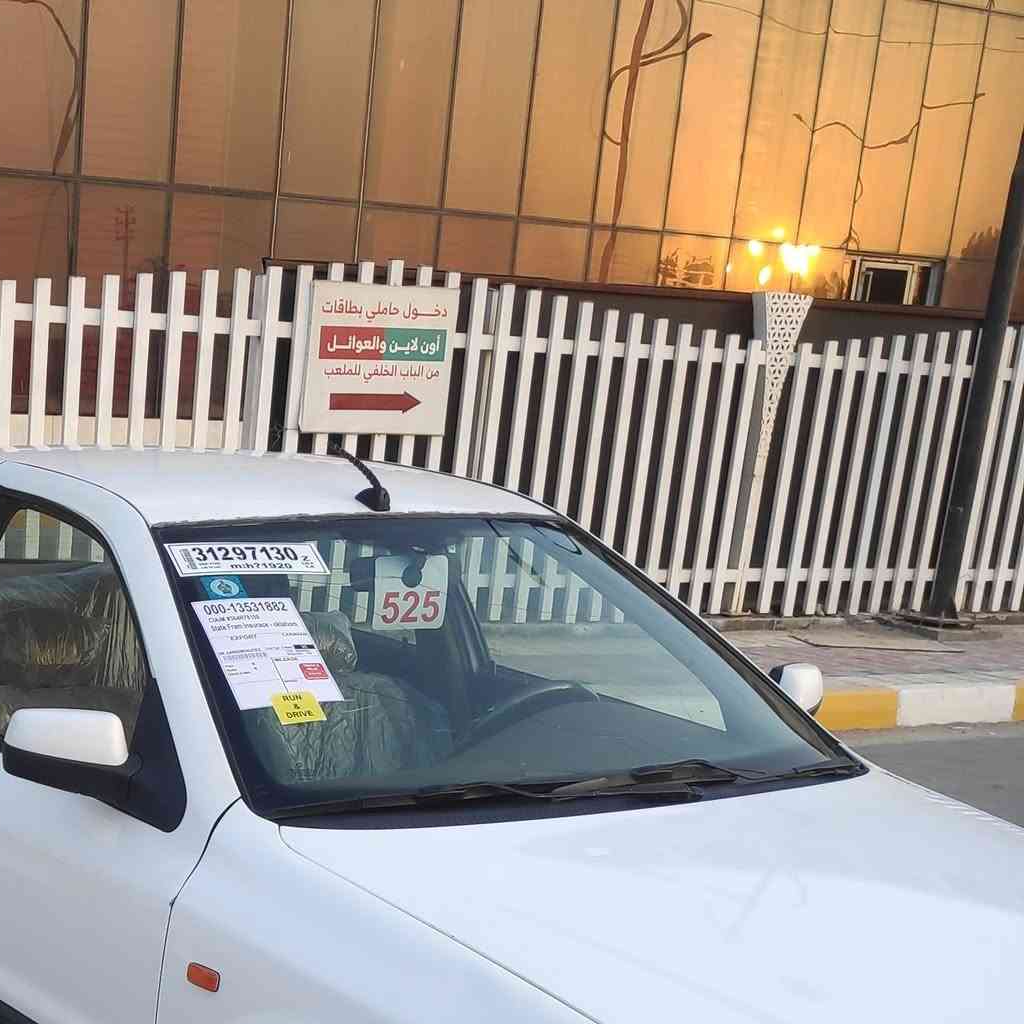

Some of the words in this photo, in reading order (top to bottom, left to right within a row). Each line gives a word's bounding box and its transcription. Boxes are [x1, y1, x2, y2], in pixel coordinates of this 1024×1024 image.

[321, 297, 363, 319] بطاقات
[365, 301, 400, 322] حاملي
[324, 363, 361, 379] للملعب
[363, 364, 397, 383] الخلفي
[399, 366, 424, 380] الباب
[425, 370, 440, 379] من
[192, 547, 298, 561] 31297130
[381, 591, 441, 624] 525
[286, 710, 314, 719] DRIVE
